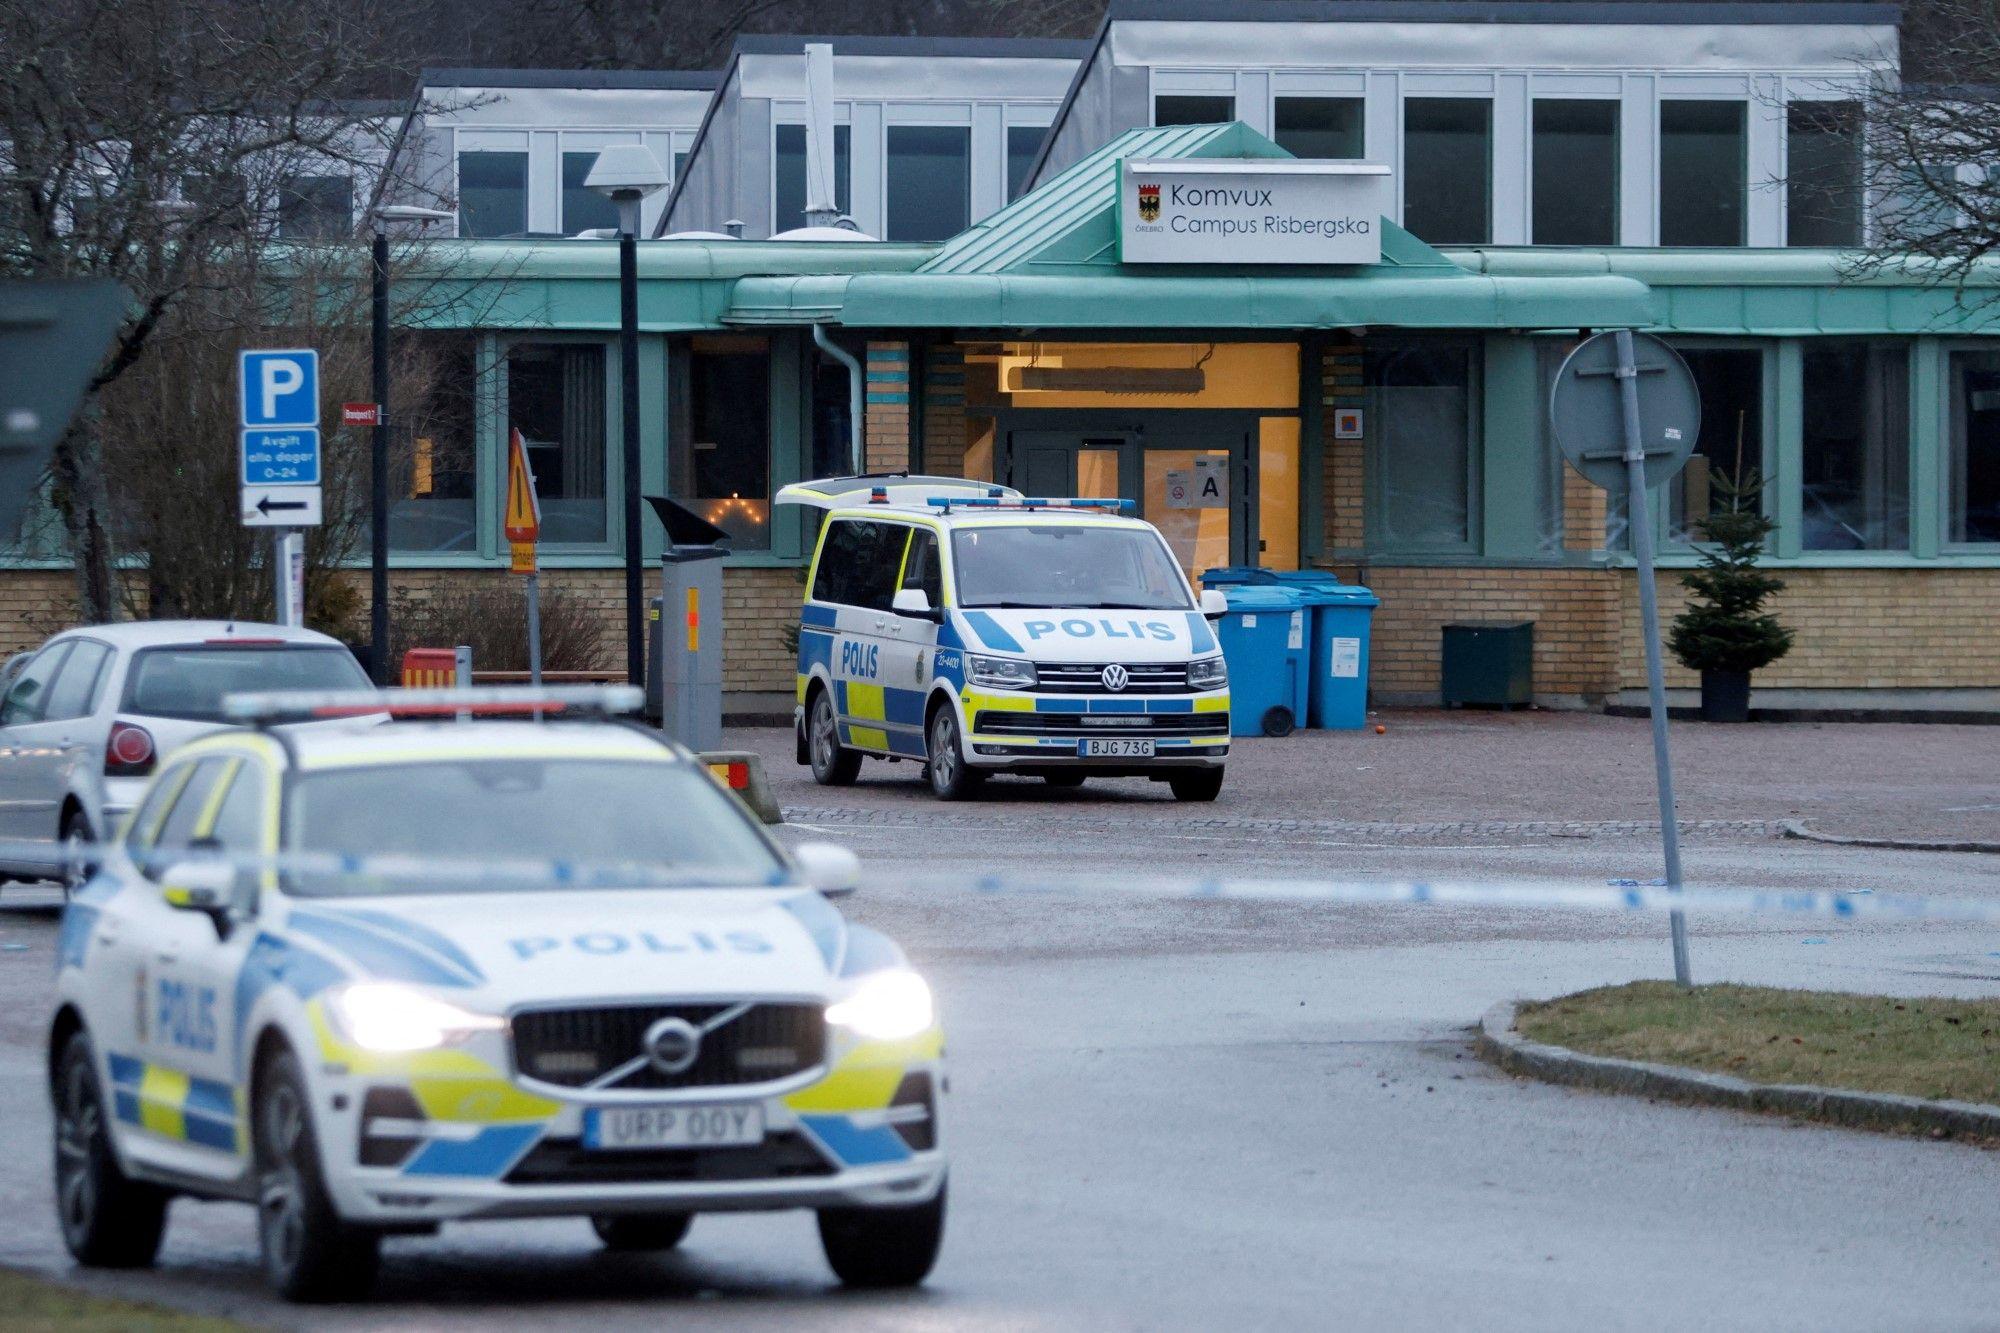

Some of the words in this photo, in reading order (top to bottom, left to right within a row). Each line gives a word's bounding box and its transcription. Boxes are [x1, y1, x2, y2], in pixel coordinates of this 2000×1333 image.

[1171, 184, 1272, 207] Komvux
[1135, 225, 1164, 233] ÖREBRO
[1171, 215, 1257, 237] Campus
[1264, 216, 1370, 238] Risbergska
[262, 359, 304, 418] P
[262, 436, 300, 448] Avgift
[249, 453, 272, 463] alle
[276, 452, 313, 464] dagar
[1202, 476, 1219, 497] A
[1023, 619, 1177, 642] POLIS
[842, 640, 879, 679] POLIS
[1092, 741, 1118, 754] BJG
[1123, 741, 1149, 754] 73G
[508, 931, 774, 960] POLIS
[158, 978, 216, 1053] POLIS
[614, 1111, 675, 1140] URP
